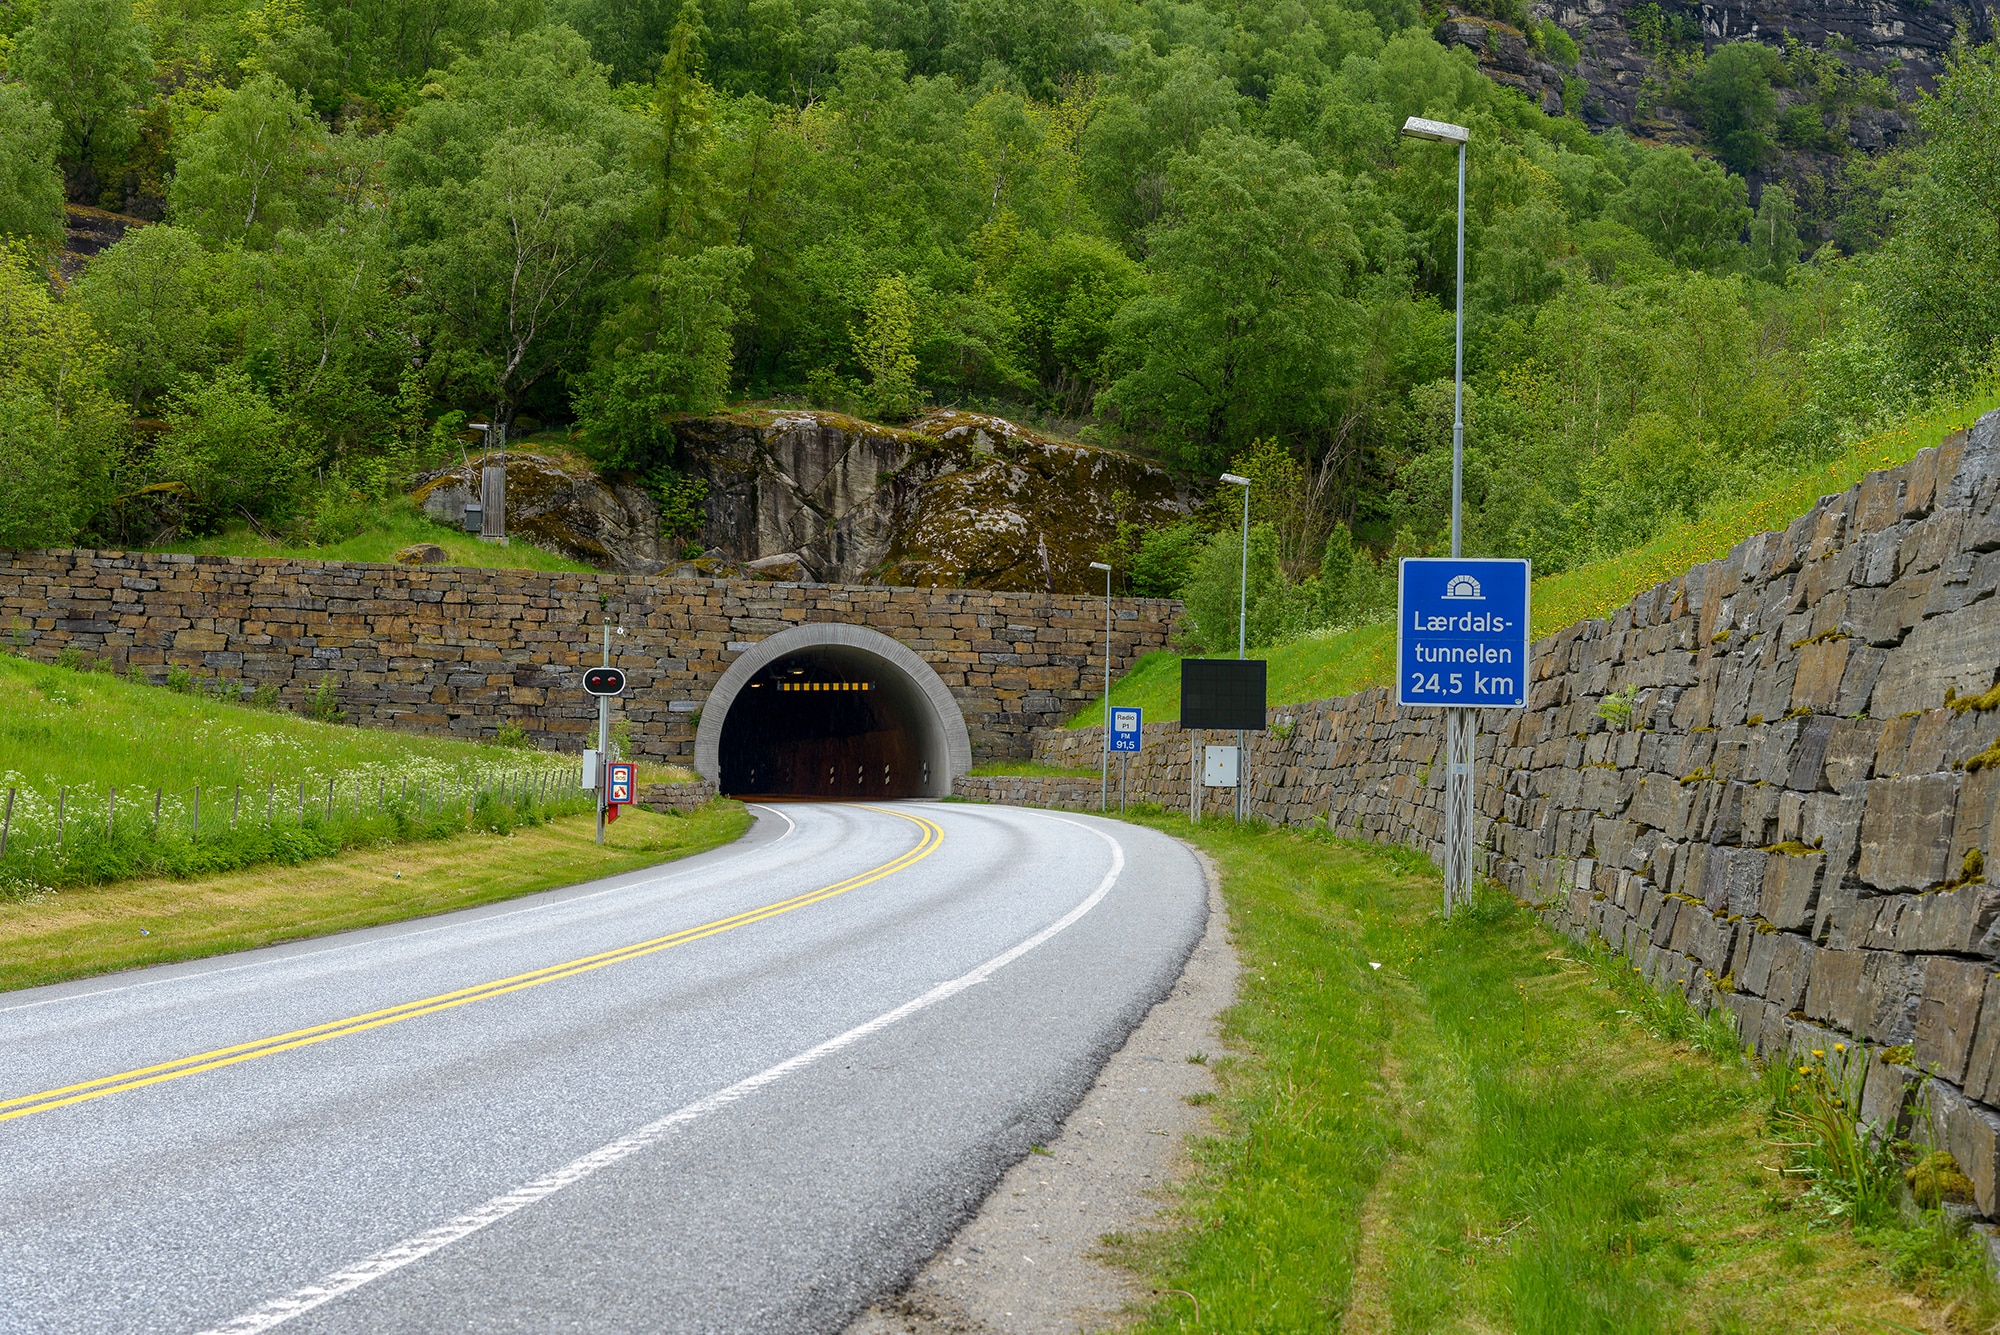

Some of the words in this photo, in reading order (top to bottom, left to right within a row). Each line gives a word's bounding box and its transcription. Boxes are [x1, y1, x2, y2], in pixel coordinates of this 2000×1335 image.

[1414, 611, 1513, 632] Lærdals-
[1415, 642, 1512, 664] tunnelen
[1411, 672, 1463, 696] 24,5
[1474, 671, 1514, 695] km
[1116, 740, 1135, 750] 91,5
